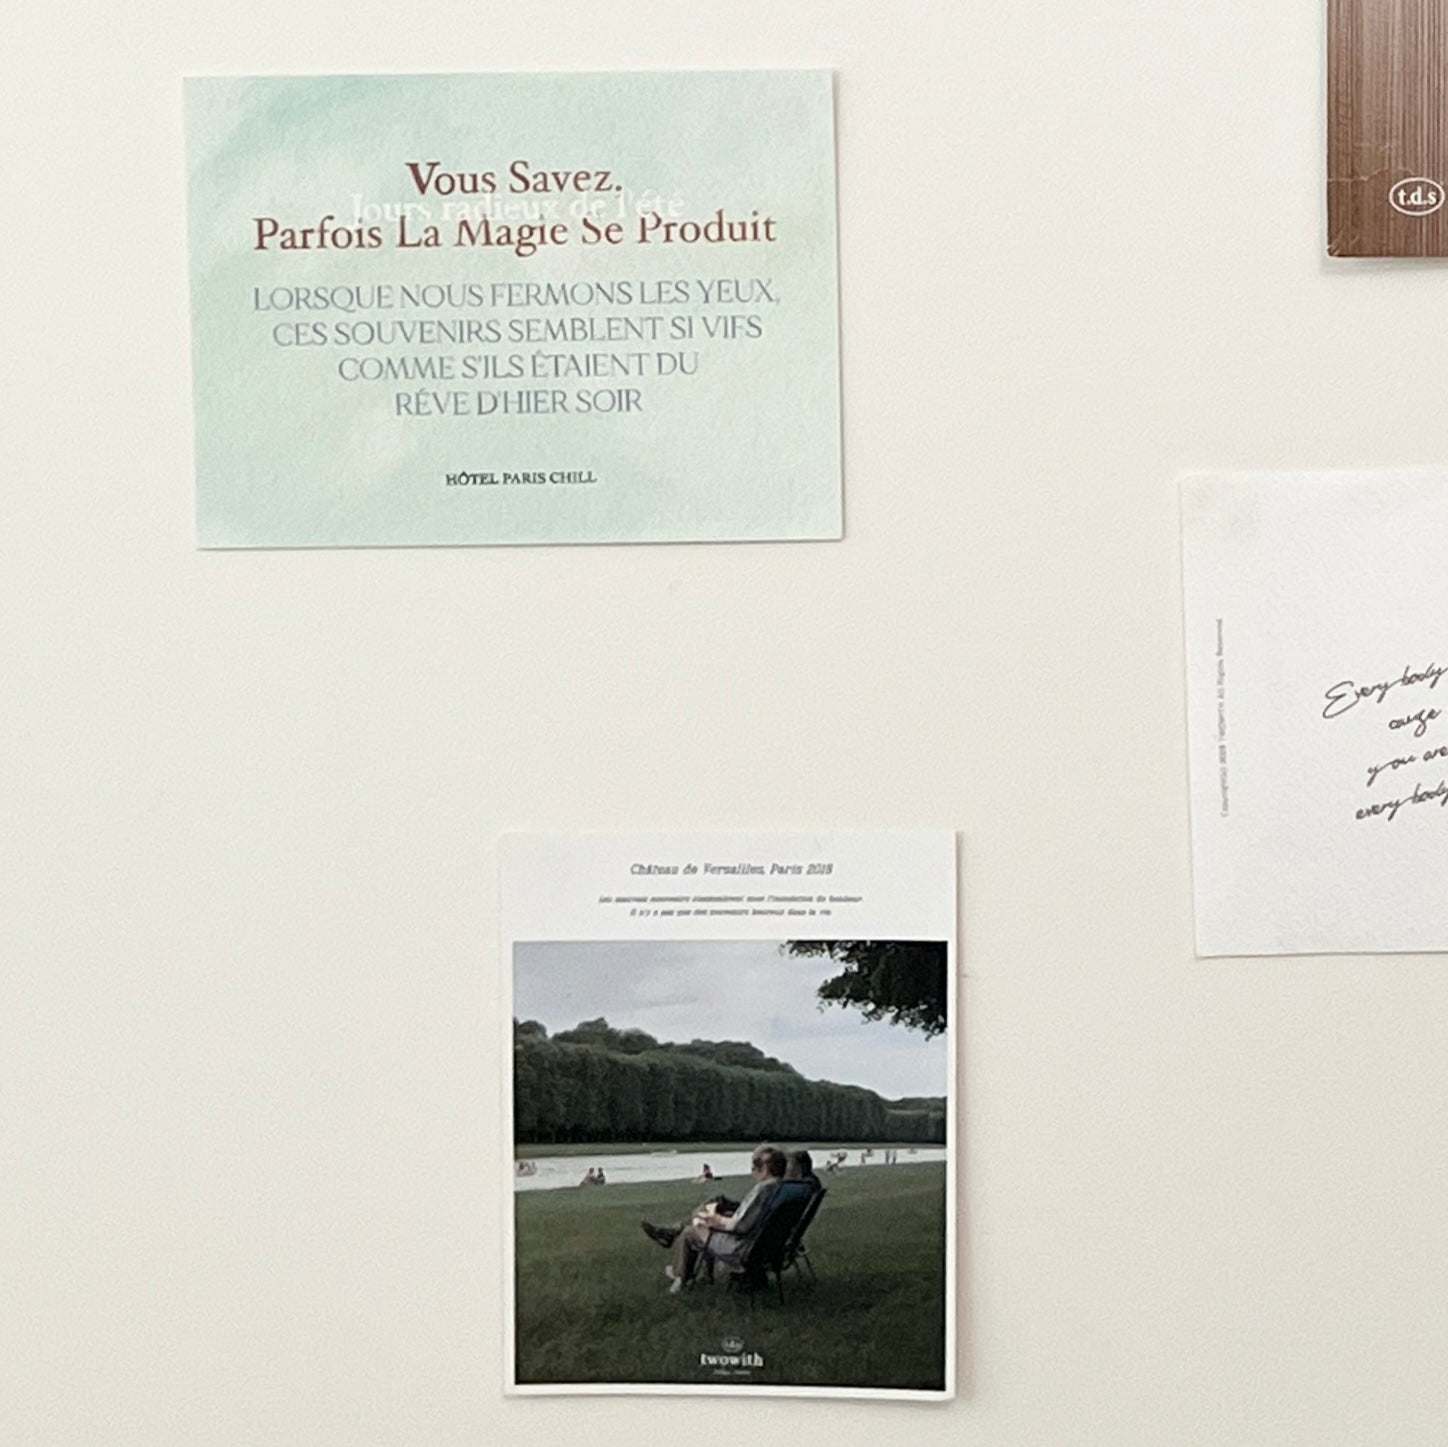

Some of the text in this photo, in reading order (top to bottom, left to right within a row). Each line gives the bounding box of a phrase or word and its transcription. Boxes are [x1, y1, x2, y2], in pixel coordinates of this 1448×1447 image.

[405, 160, 623, 195] Vous Savez.
[1397, 185, 1437, 206] t.d.s
[253, 209, 777, 257] Parfois La Magie Se Produit
[253, 278, 780, 313] LORSQUE NOUS FERMONS LES YEUX,
[273, 315, 763, 347] CES SOUVENIRS SEMBLENT SI VIFS
[338, 356, 455, 381] COMME
[461, 354, 524, 380] S'ILS
[657, 352, 699, 376] DU
[477, 390, 570, 415] D'HIER
[576, 389, 643, 413] SOIR
[446, 471, 598, 486] HÔTEL PARIS CHILL
[1367, 755, 1417, 787] you
[770, 863, 803, 875] Paris
